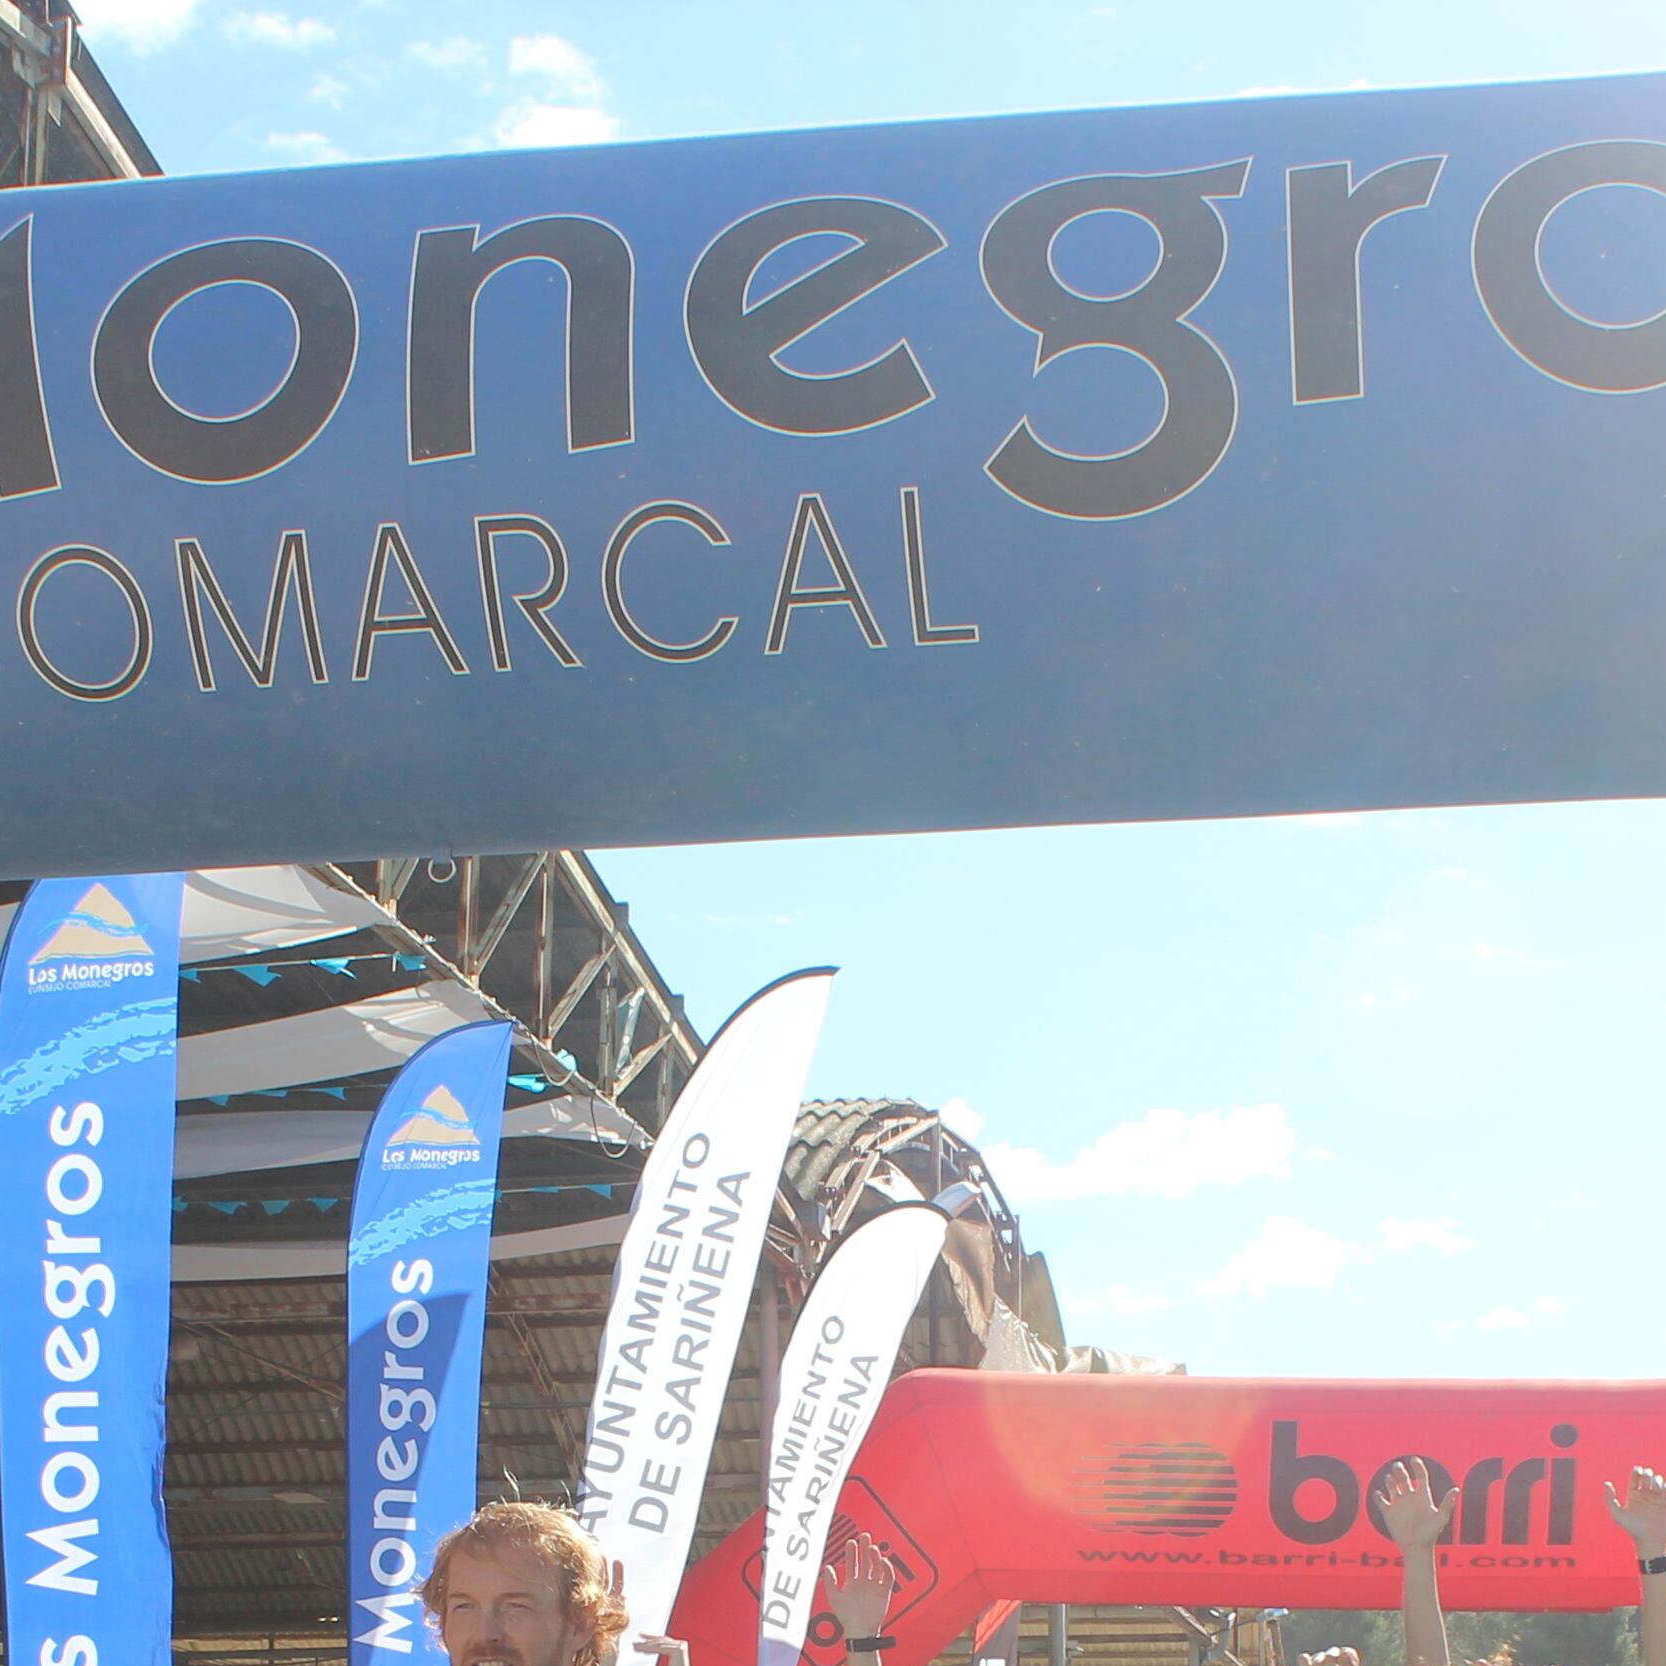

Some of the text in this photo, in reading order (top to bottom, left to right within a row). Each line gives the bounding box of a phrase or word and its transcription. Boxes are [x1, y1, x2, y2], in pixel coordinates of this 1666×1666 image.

[29, 962, 155, 986] Los Monegros
[25, 1101, 116, 1596] Monegros
[353, 1259, 436, 1654] Monegros
[580, 1132, 712, 1536] AYUNTAMIENTO
[628, 1169, 752, 1535] DE SARIÑENA
[762, 1570, 802, 1630] DE
[787, 1354, 879, 1562] SARIÑENA
[1268, 1420, 1579, 1546] barri
